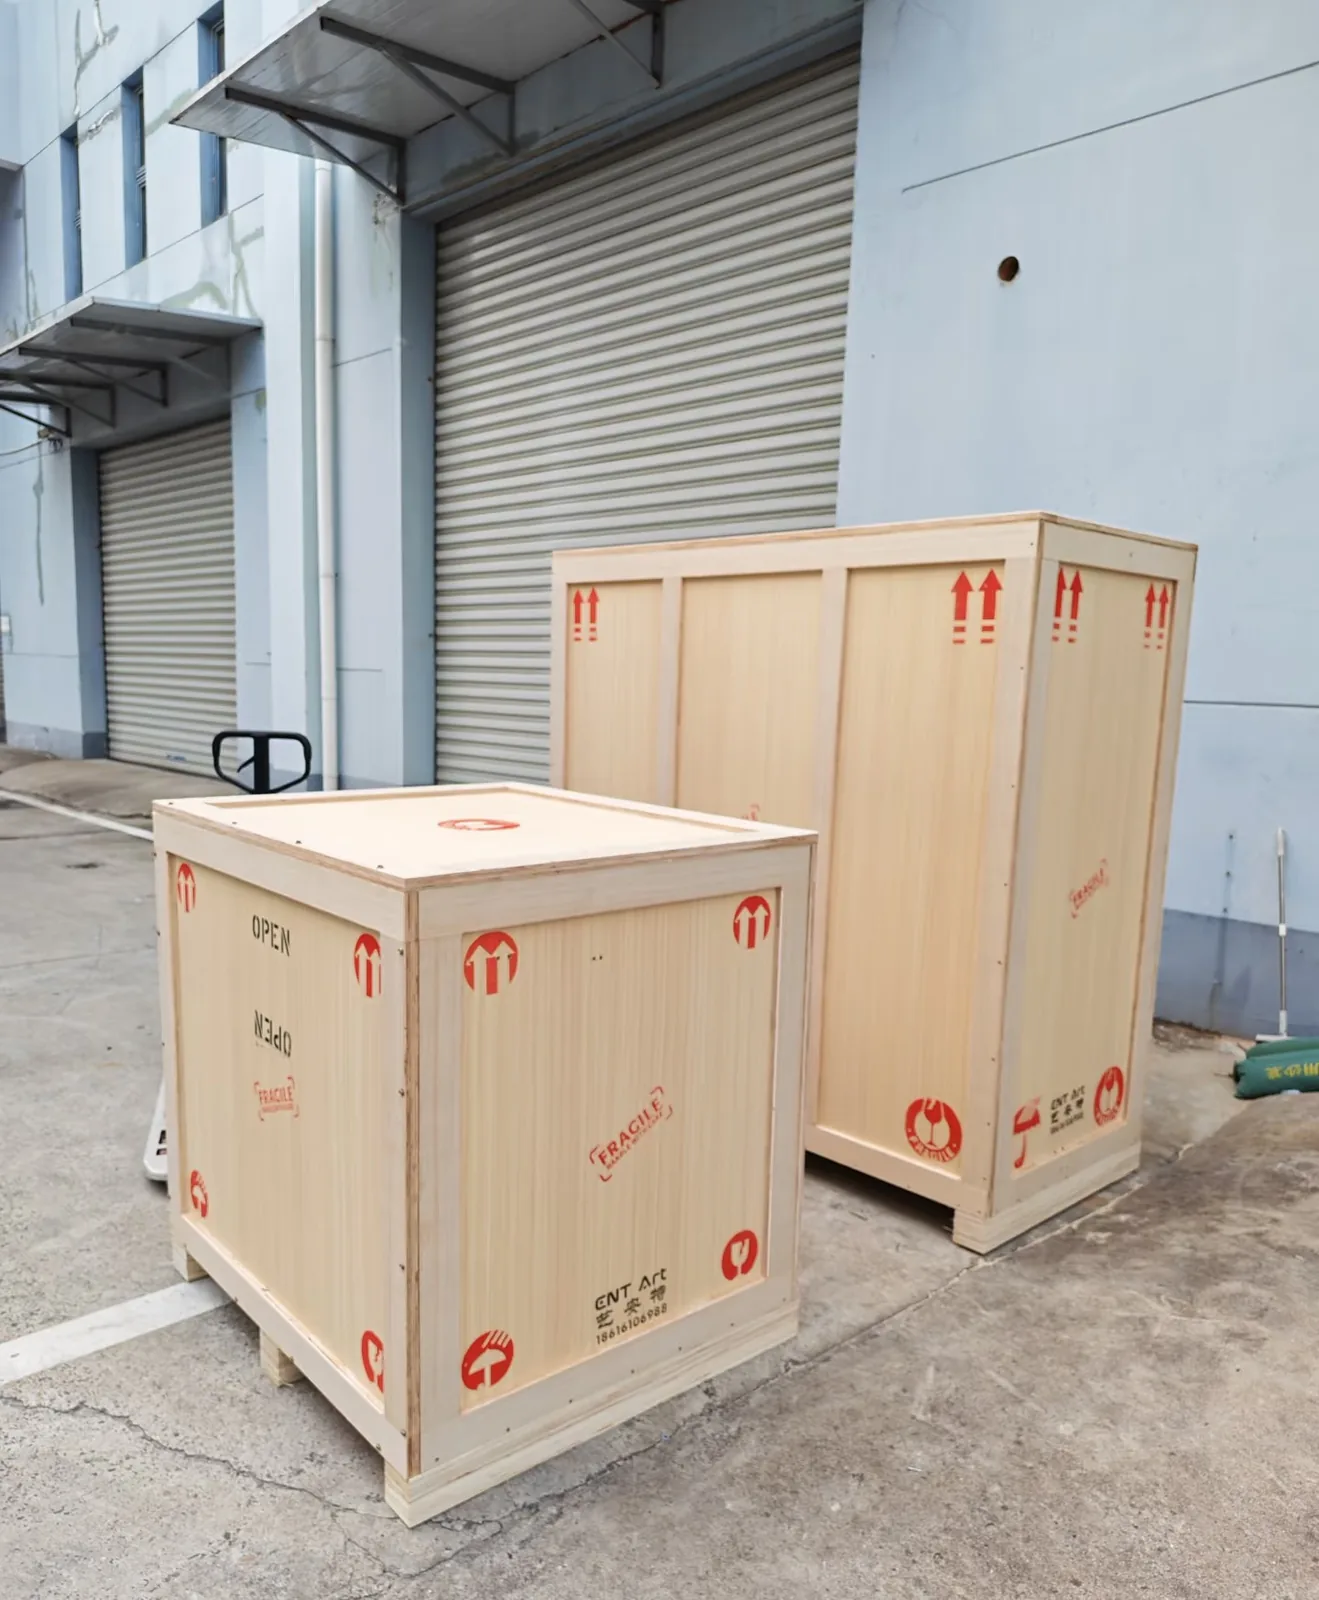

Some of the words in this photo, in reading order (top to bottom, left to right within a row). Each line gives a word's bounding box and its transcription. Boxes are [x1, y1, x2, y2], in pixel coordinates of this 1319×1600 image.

[252, 914, 290, 957] OPEN
[254, 1009, 292, 1058] OPEN
[597, 1096, 664, 1165] FRAGILE
[595, 1282, 632, 1311] ENT
[638, 1268, 667, 1292] Art
[595, 1303, 668, 1345] 18616106988
